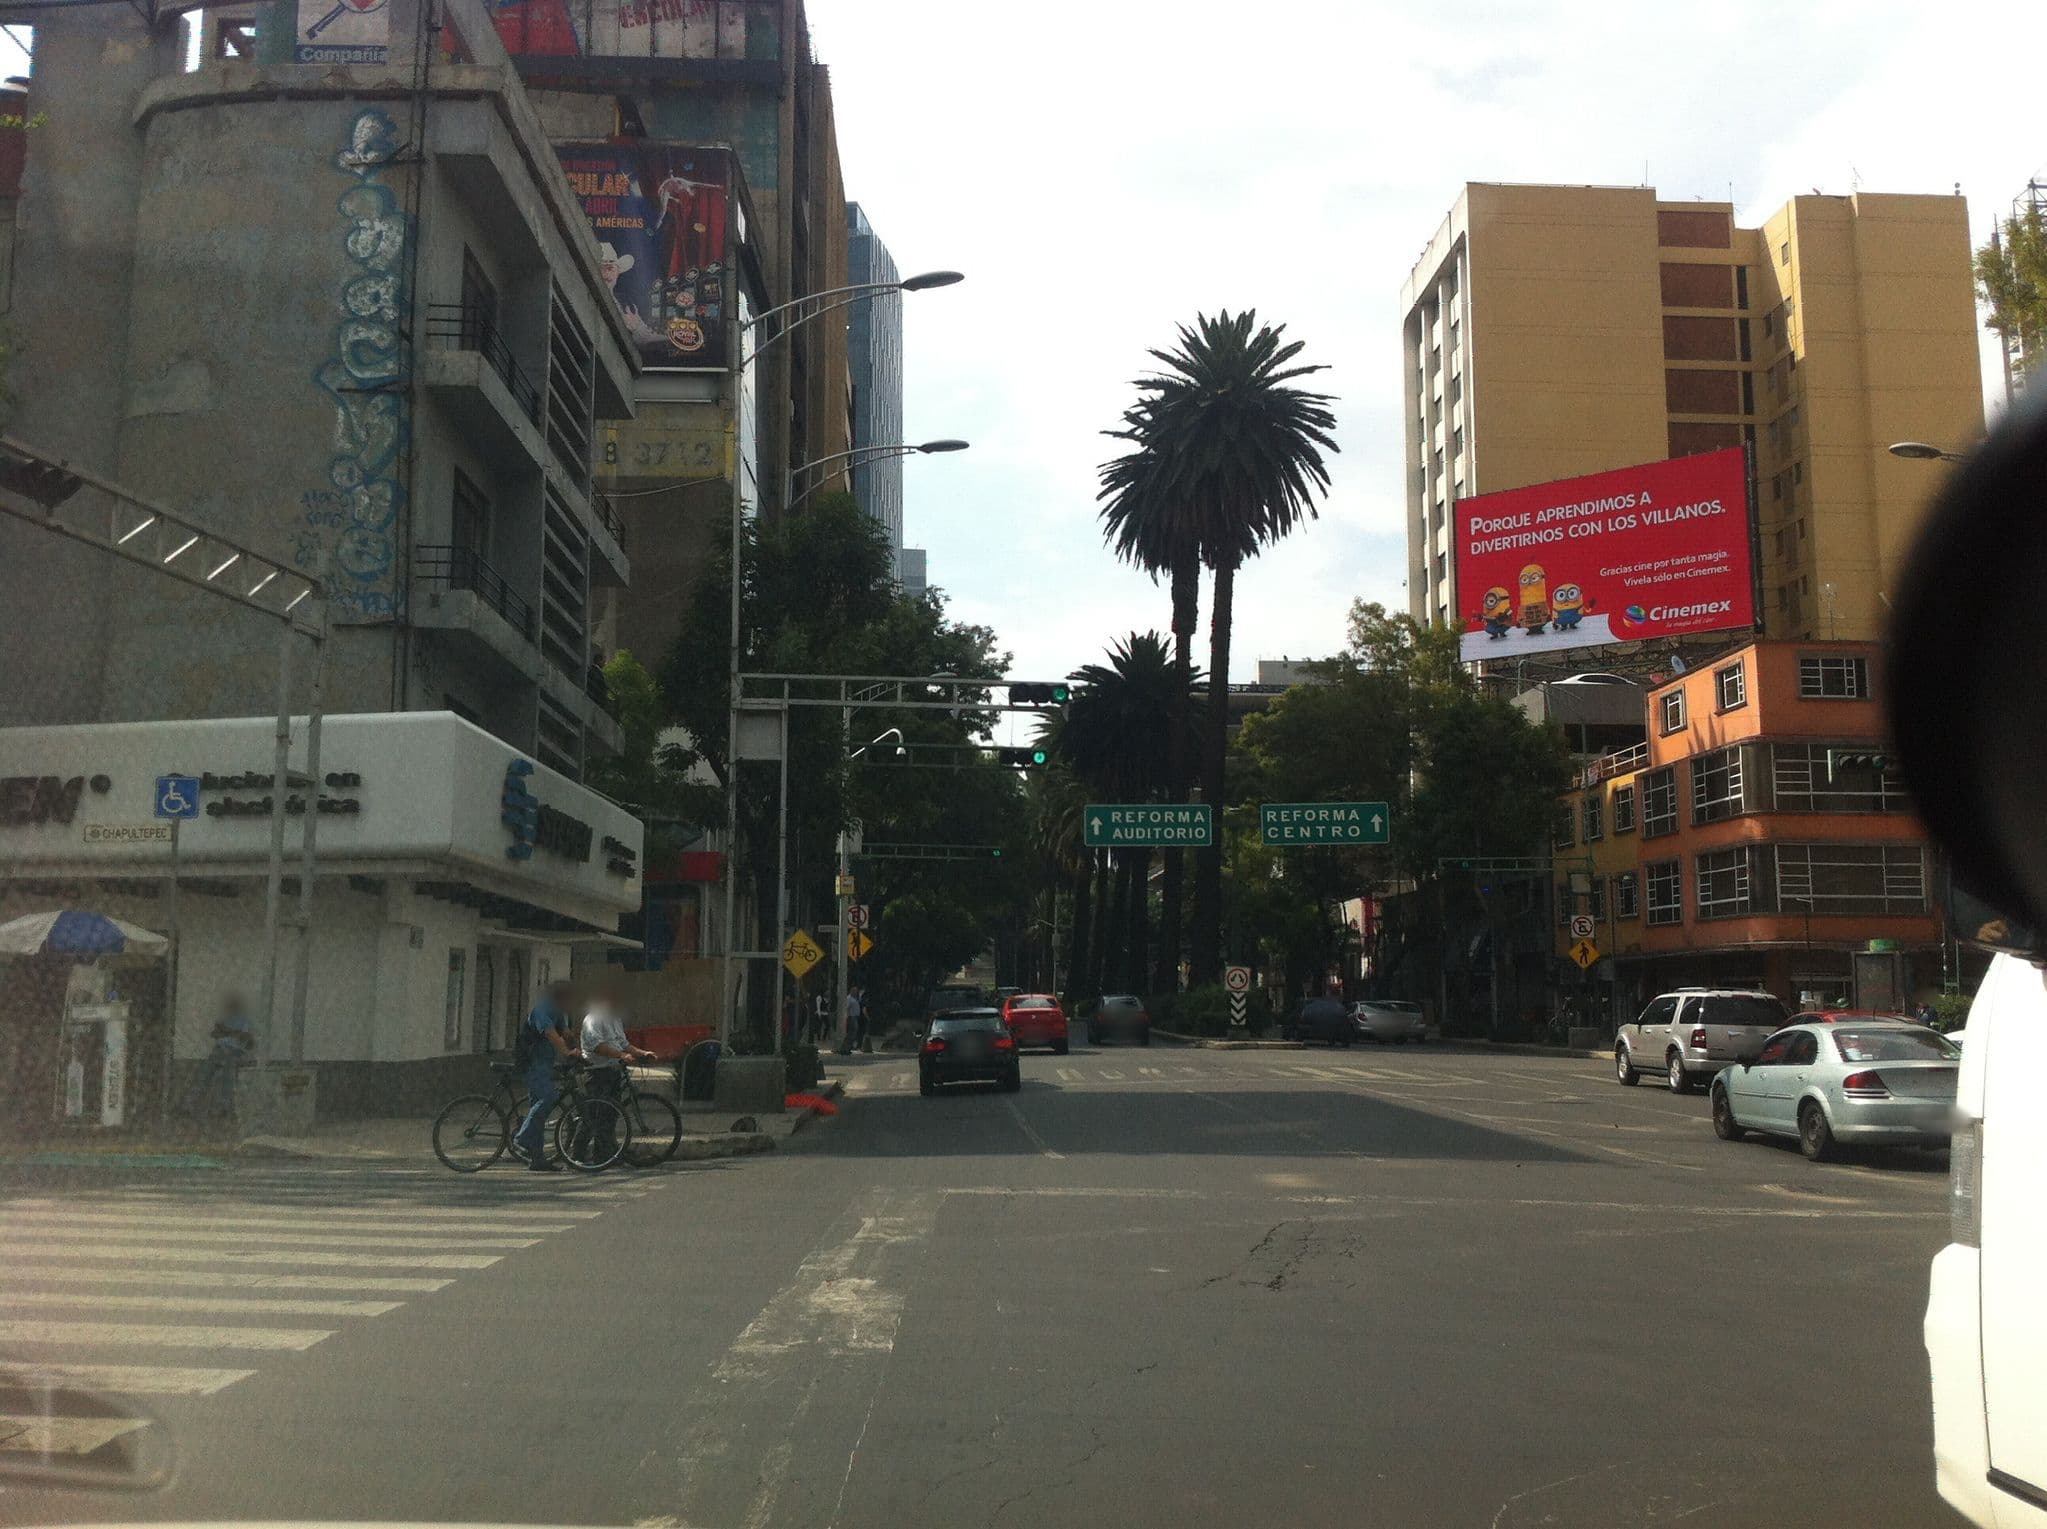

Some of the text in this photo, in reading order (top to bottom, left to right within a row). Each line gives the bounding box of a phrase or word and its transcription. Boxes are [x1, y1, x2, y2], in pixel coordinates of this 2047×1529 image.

[596, 216, 644, 229] AMÉRICAS
[1470, 491, 1652, 535] PORQUE APRENDIMOS A
[1470, 499, 1726, 555] DIVERTIRNOS CON LOS VILLANOS.
[1600, 564, 1633, 577] Gracias
[1634, 561, 1653, 571] cine
[1653, 559, 1669, 571] por
[1670, 555, 1696, 566] tanta
[1673, 571, 1686, 580] en
[1686, 565, 1731, 578] Cinemex.
[1649, 600, 1732, 621] Cinemex
[1111, 811, 1205, 823] REFORMA
[1266, 809, 1360, 822] REFORMA
[102, 827, 168, 840] CHAPULTEPEC
[1112, 827, 1206, 840] AUDITORIO
[1267, 825, 1361, 838] CENTRO
